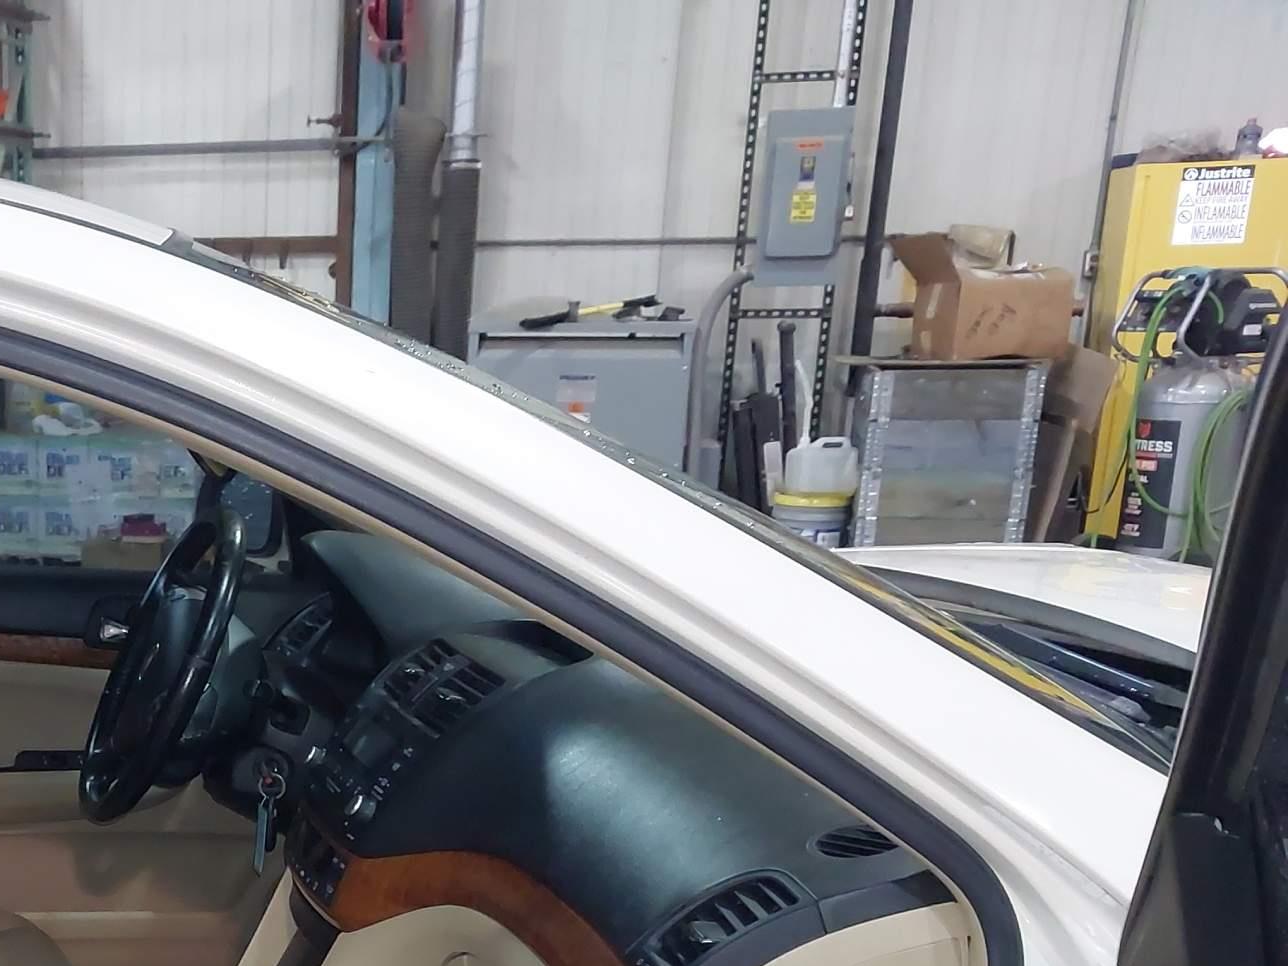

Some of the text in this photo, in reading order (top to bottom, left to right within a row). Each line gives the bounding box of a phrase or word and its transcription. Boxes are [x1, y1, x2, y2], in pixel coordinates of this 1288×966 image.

[1198, 167, 1252, 180] Justrite
[1196, 180, 1252, 197] FLAMMABLE
[1194, 203, 1247, 221] INFLAMABLE
[1136, 439, 1173, 453] TRESS
